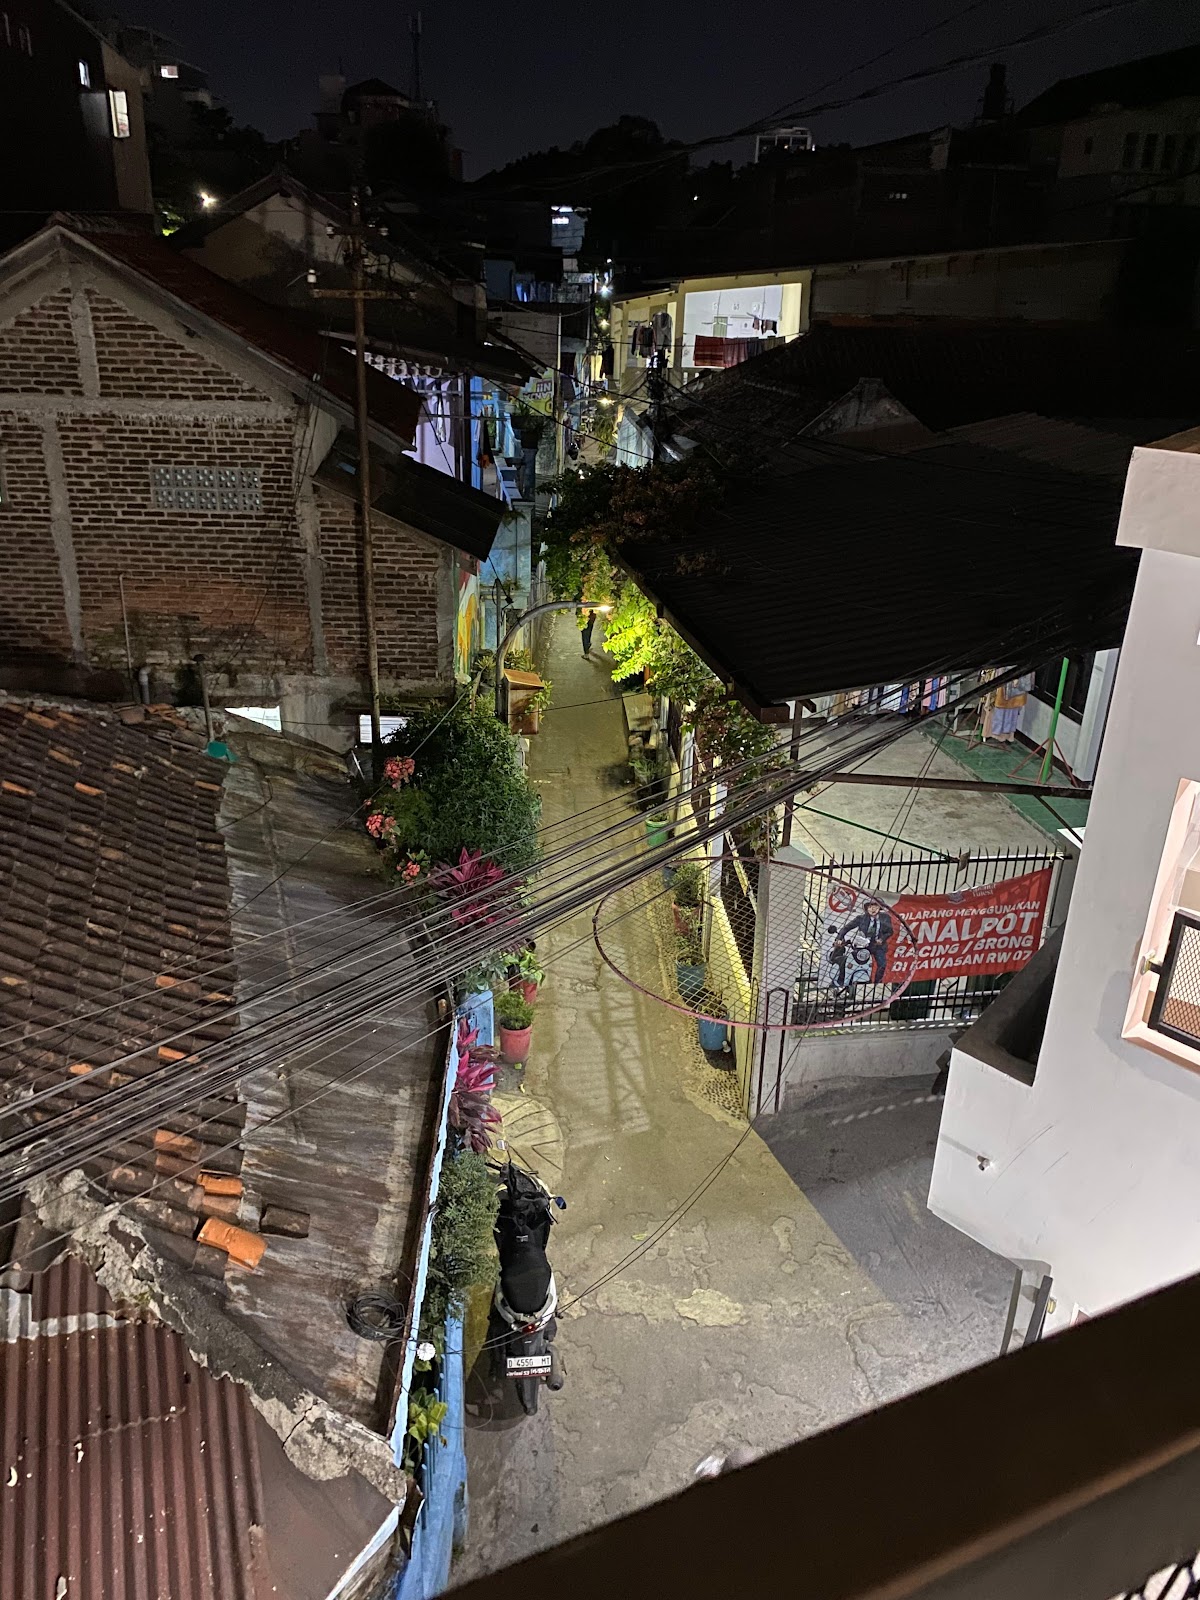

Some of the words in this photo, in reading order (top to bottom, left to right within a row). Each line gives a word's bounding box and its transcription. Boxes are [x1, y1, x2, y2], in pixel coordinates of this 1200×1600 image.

[898, 909, 953, 921] DILARANG
[955, 901, 1041, 916] MENGGUNAKAN
[896, 911, 1040, 944] KNALPOT
[894, 943, 960, 958] RACING
[961, 940, 974, 955] /
[973, 935, 1034, 951] BRONG
[891, 961, 908, 972] DI
[909, 953, 985, 971] KAWASAN
[986, 951, 1013, 963] RW
[1012, 950, 1033, 961] 07
[508, 1359, 513, 1368] D
[541, 1357, 550, 1365] MT
